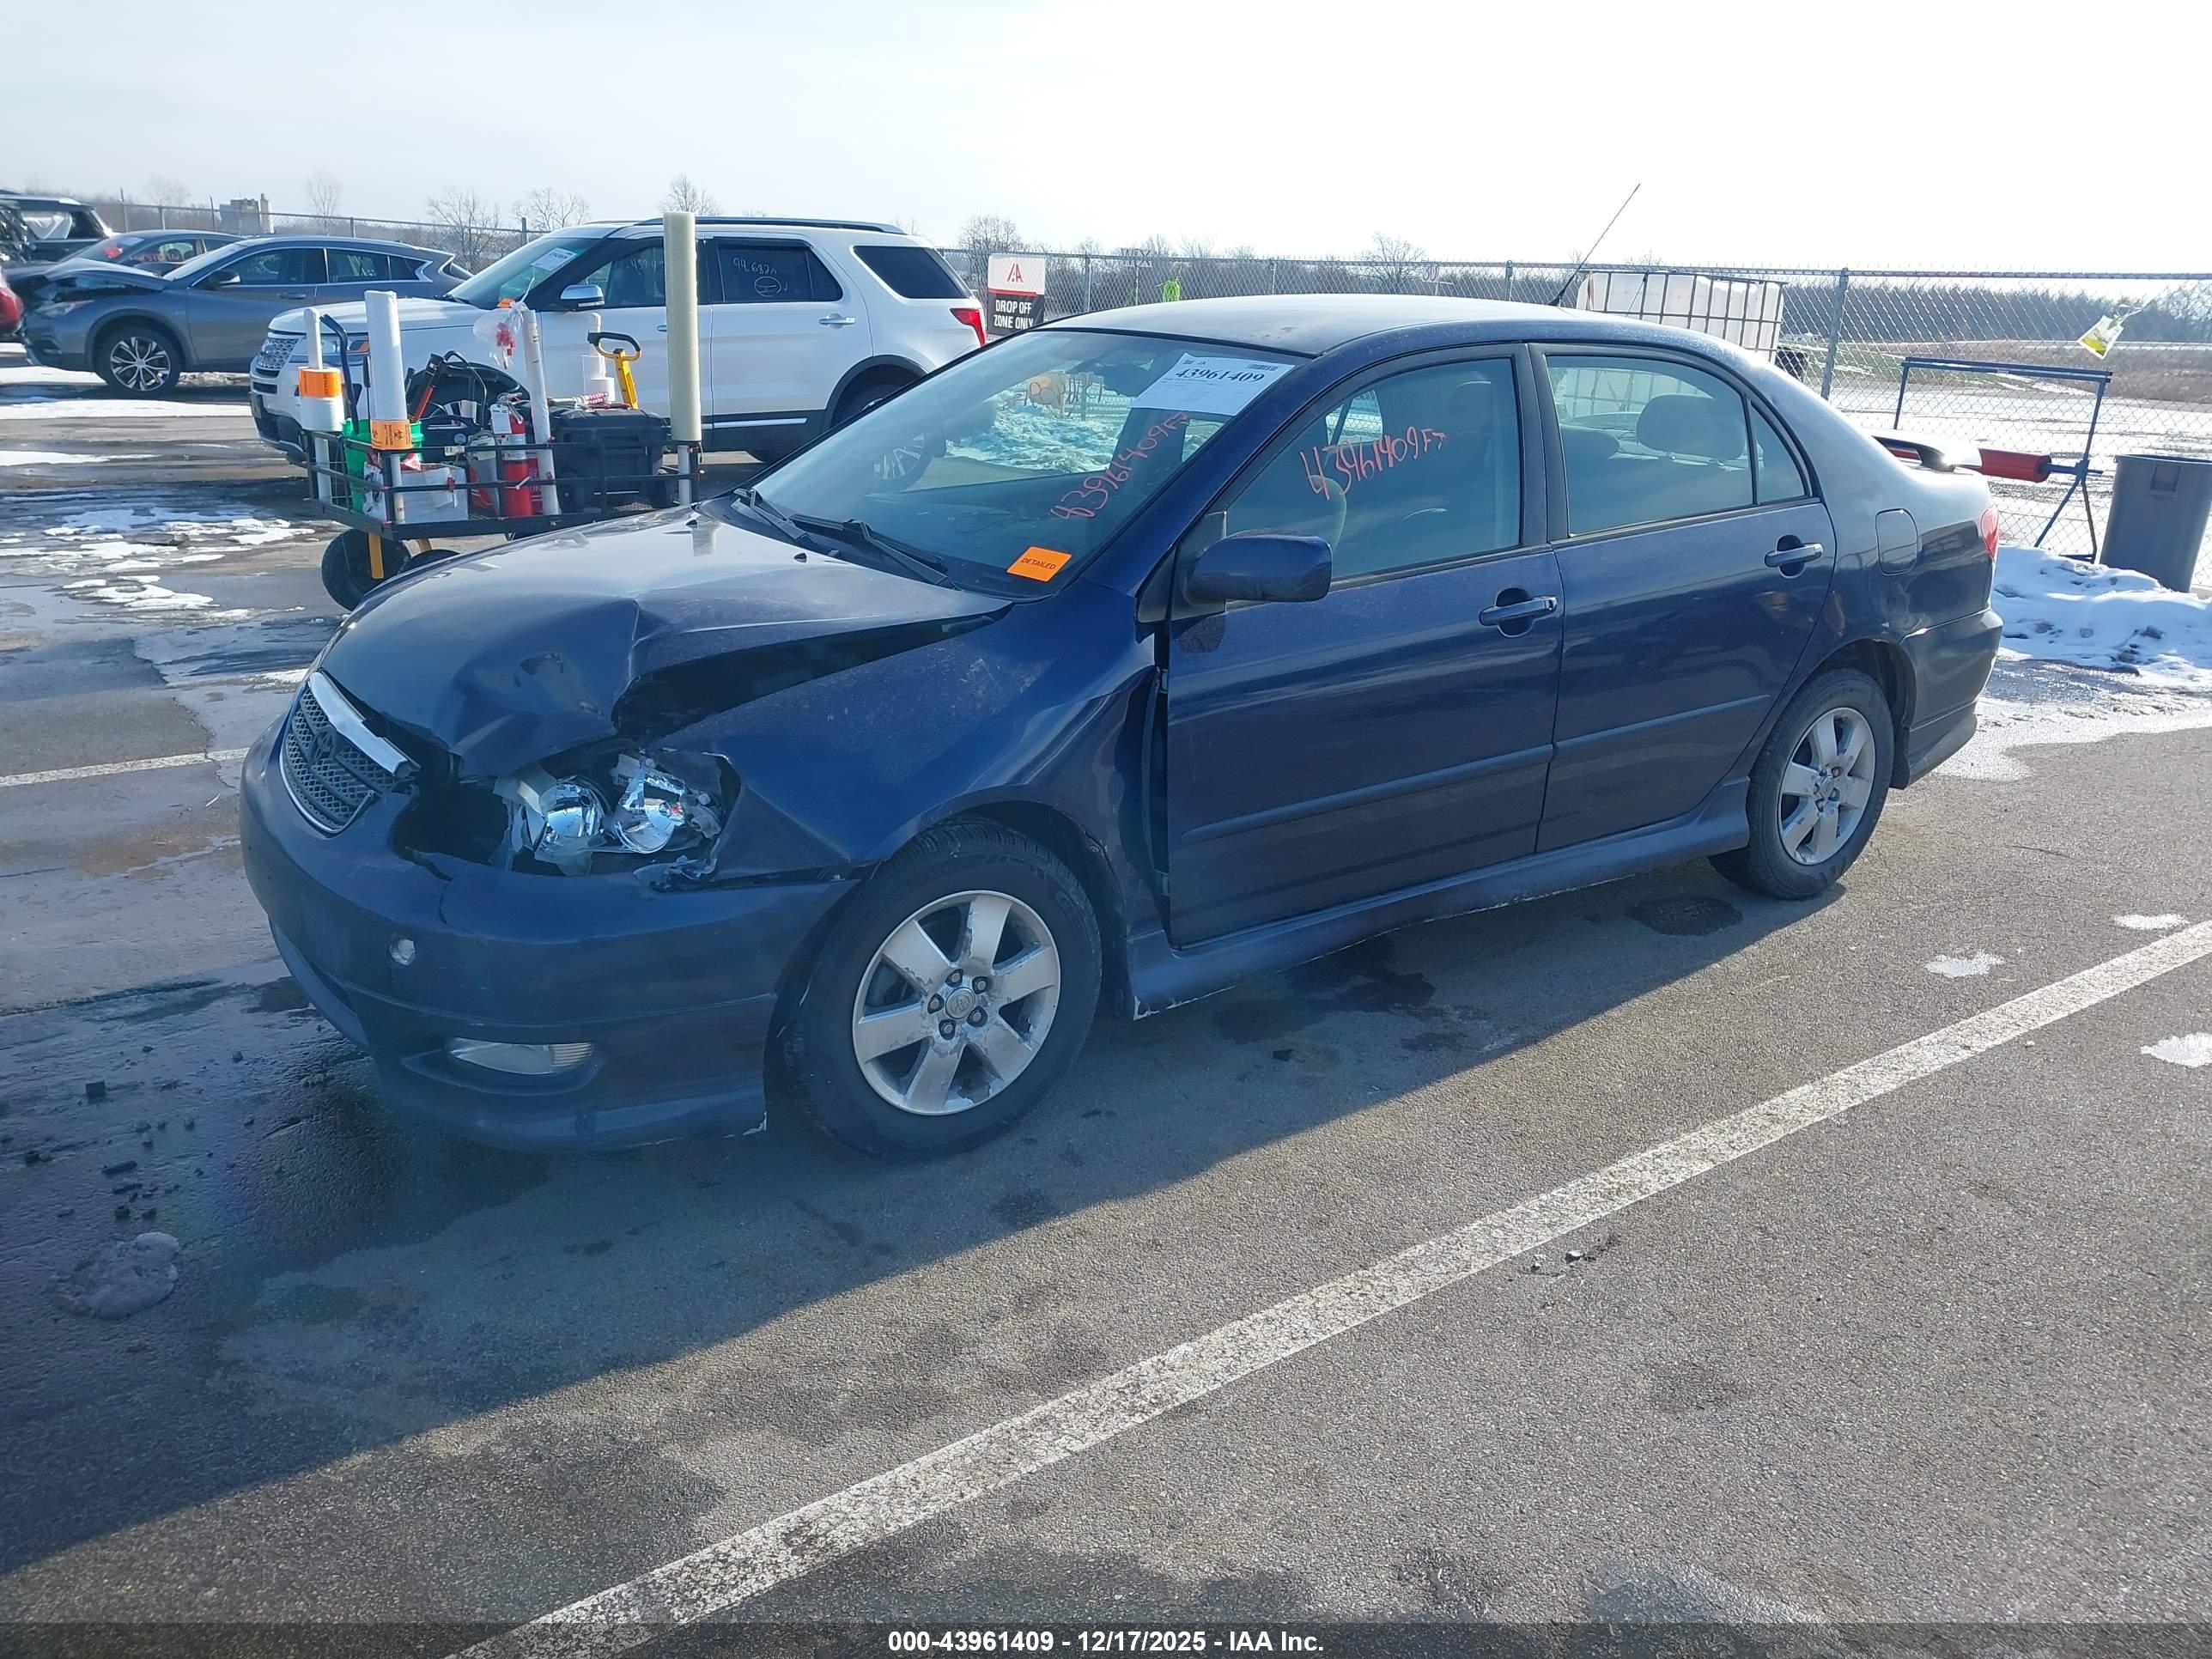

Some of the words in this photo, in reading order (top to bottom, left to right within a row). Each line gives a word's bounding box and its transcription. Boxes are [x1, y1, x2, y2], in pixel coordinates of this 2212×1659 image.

[995, 300, 1018, 313] DROP
[1018, 301, 1032, 314] OFF
[994, 314, 1014, 328] ZONE
[1015, 317, 1034, 330] ONLY
[1175, 368, 1266, 383] 43961409
[1020, 557, 1057, 570] DETAILED
